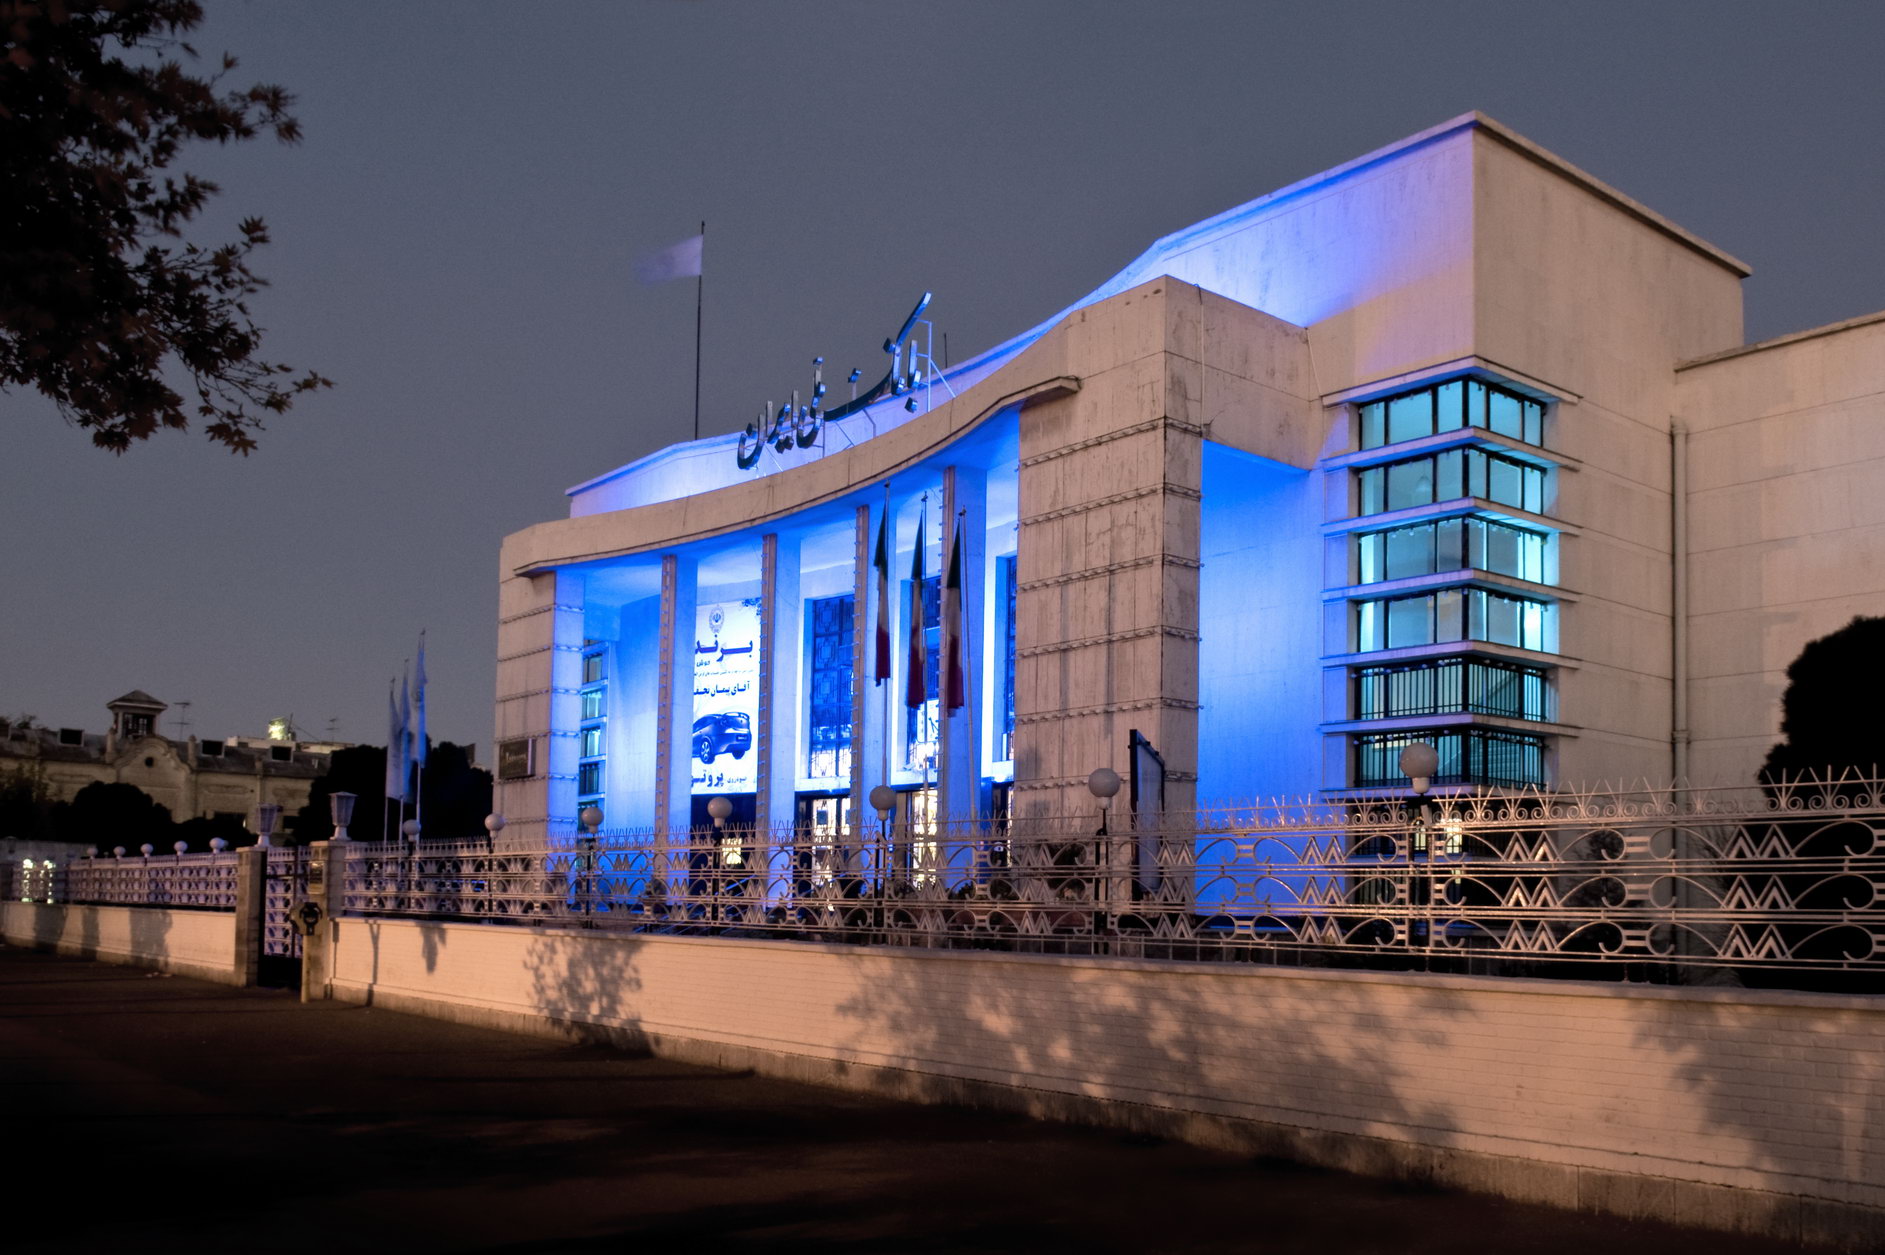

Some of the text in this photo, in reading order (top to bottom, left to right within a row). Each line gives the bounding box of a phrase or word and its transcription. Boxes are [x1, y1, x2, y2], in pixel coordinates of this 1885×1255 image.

[822, 290, 932, 423] بانک
[737, 386, 799, 470] ایران
[730, 680, 750, 696] آقای
